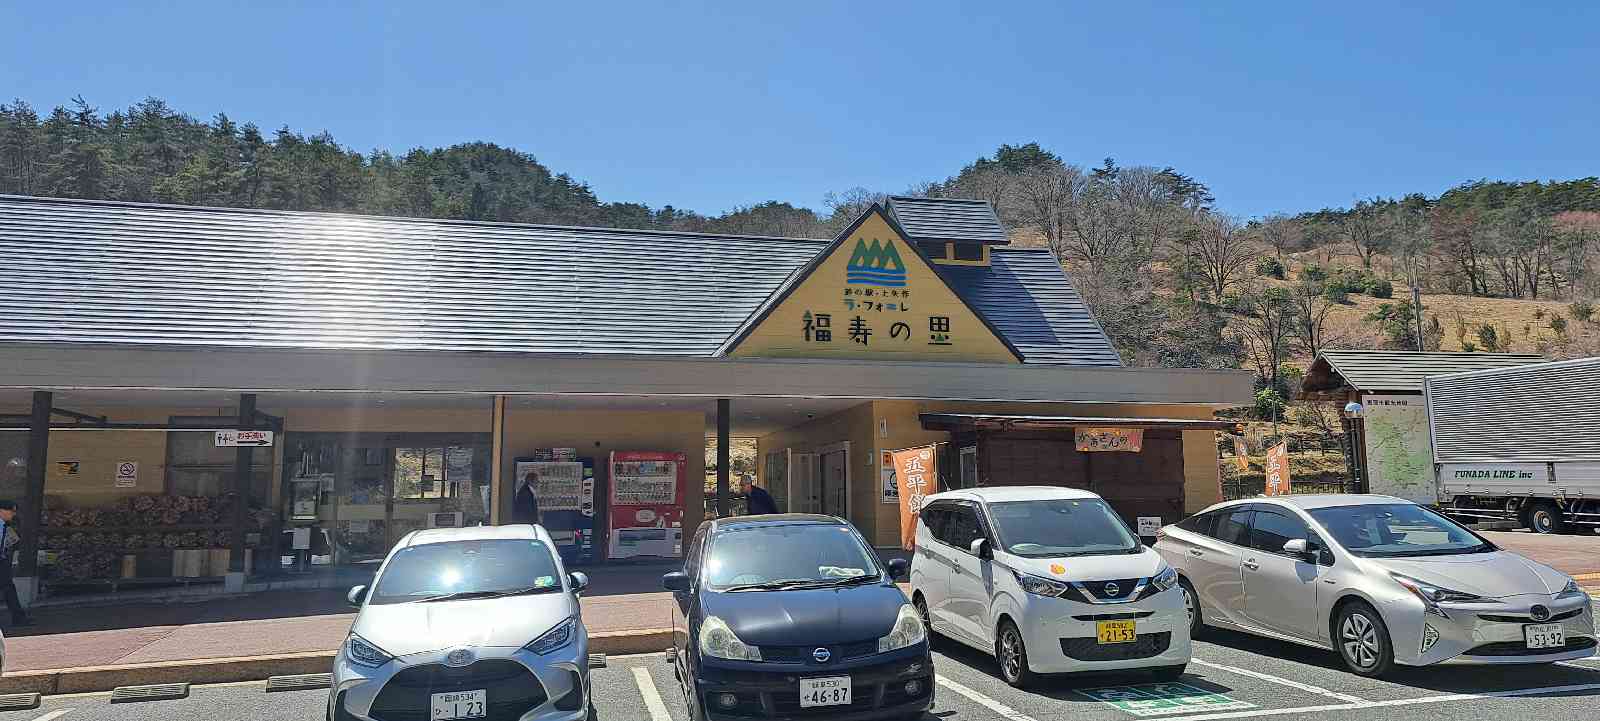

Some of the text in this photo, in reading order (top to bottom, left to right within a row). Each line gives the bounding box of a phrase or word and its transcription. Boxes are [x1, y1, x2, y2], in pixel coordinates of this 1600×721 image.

[802, 310, 953, 346] 福寿の里
[1455, 470, 1491, 478] FUNADA
[1493, 470, 1516, 479] LINE
[1534, 632, 1563, 646] 53-92
[811, 687, 848, 703] 46-87
